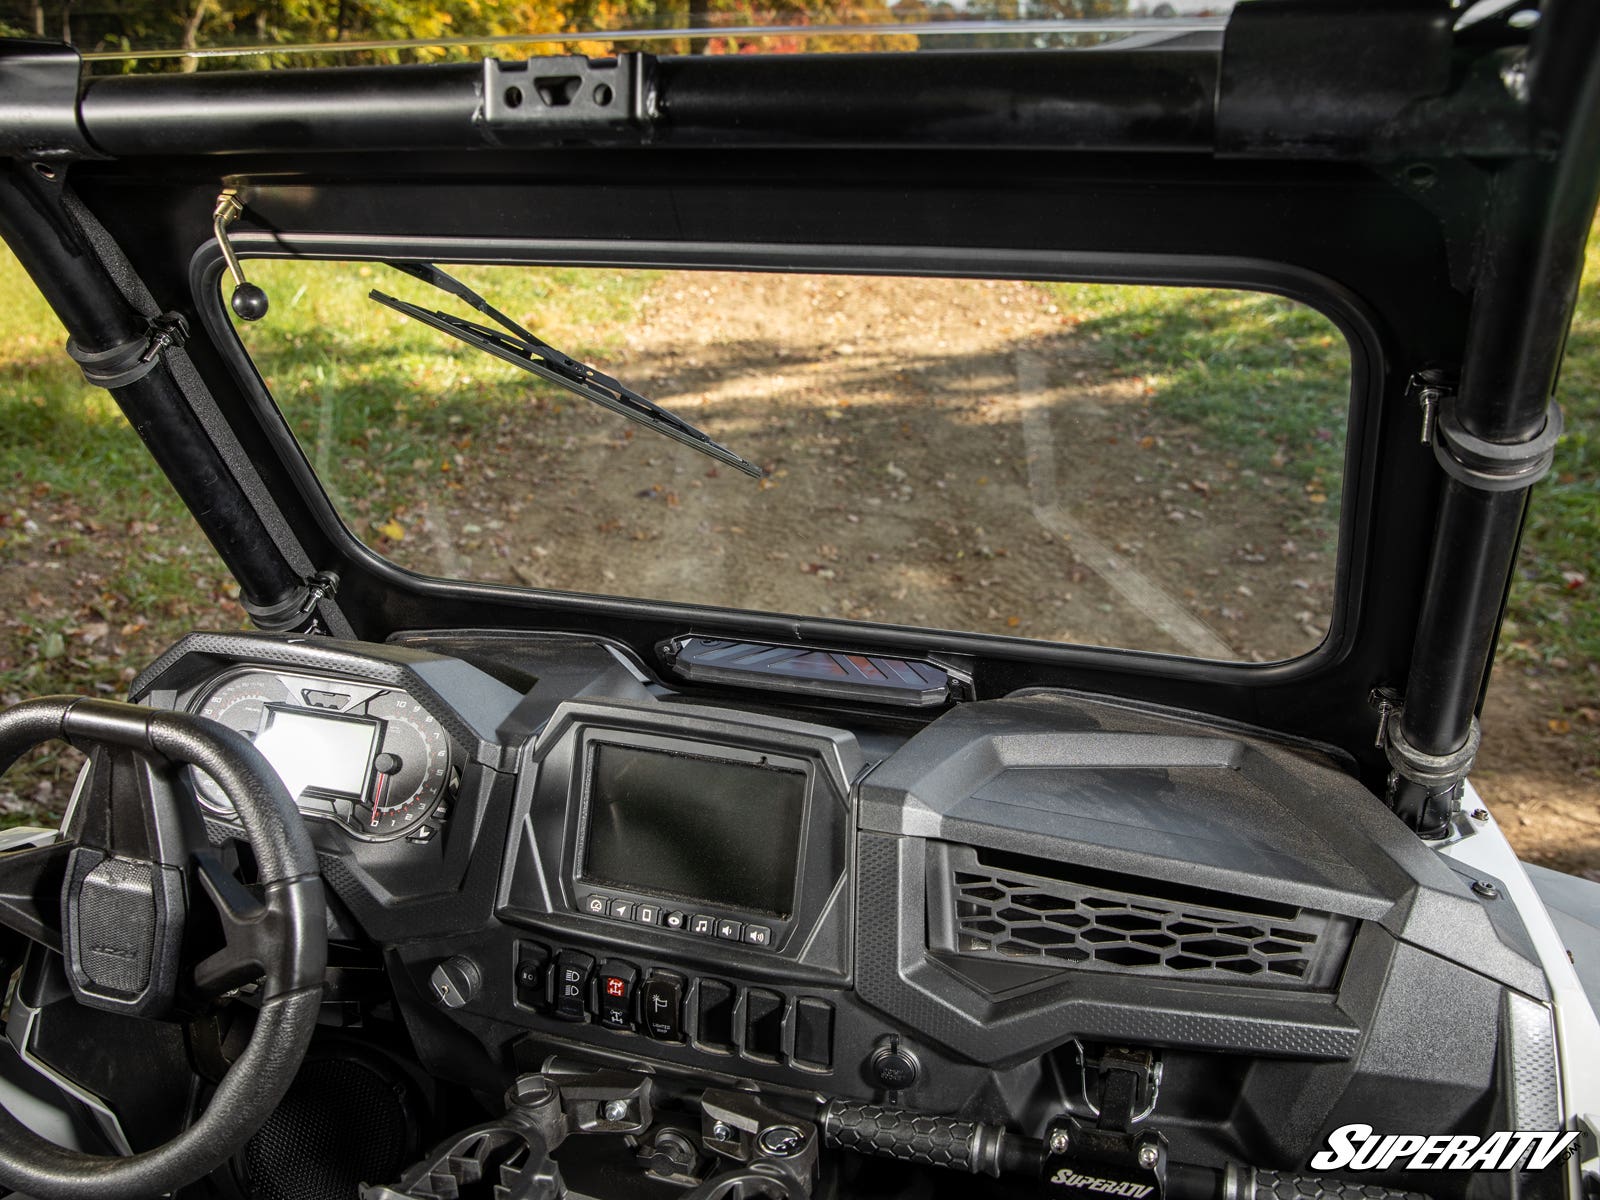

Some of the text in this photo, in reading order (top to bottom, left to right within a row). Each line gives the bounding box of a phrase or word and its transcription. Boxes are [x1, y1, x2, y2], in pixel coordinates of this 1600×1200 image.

[396, 700, 407, 708] 10
[425, 715, 434, 723] 8
[418, 802, 426, 810] 3
[405, 813, 413, 821] 2
[1050, 1168, 1154, 1199] SUPERATV
